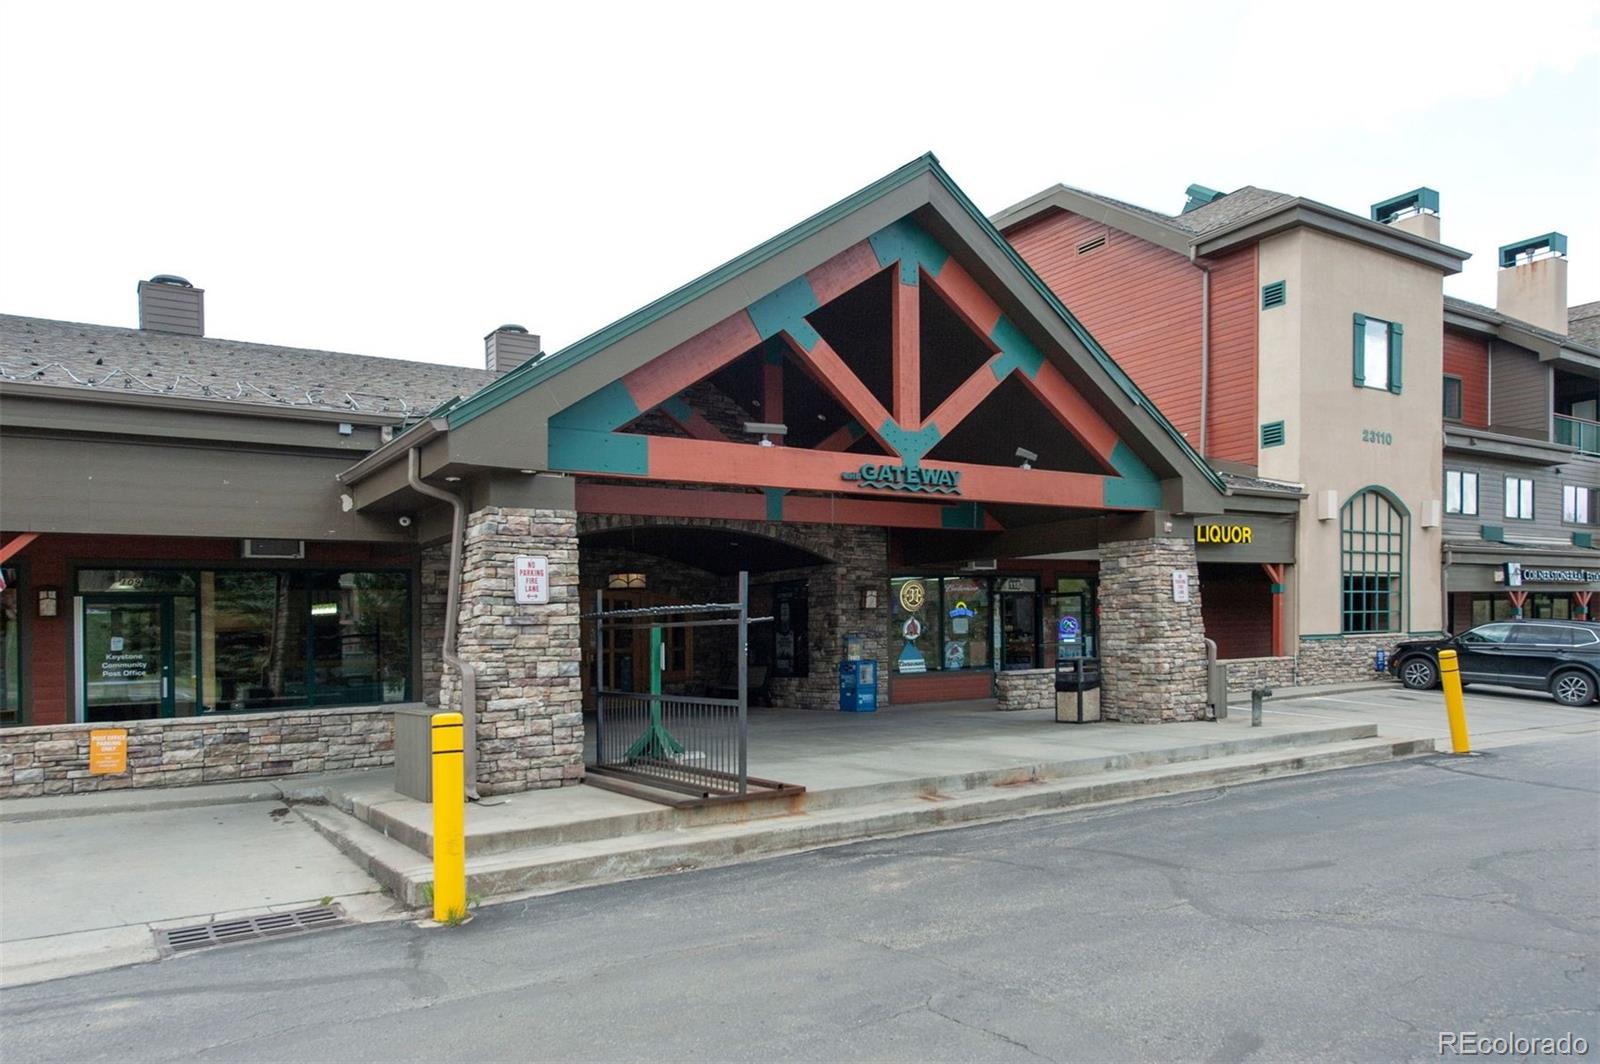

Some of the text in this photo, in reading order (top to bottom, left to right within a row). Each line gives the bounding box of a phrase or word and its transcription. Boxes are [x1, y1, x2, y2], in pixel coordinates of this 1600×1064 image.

[1362, 429, 1392, 446] 23110
[860, 463, 962, 486] GATEWAY
[1197, 525, 1252, 543] LIQUOR
[528, 561, 536, 569] NO
[519, 569, 544, 577] PARKING
[106, 654, 143, 662] Keystone
[123, 669, 146, 677] Office
